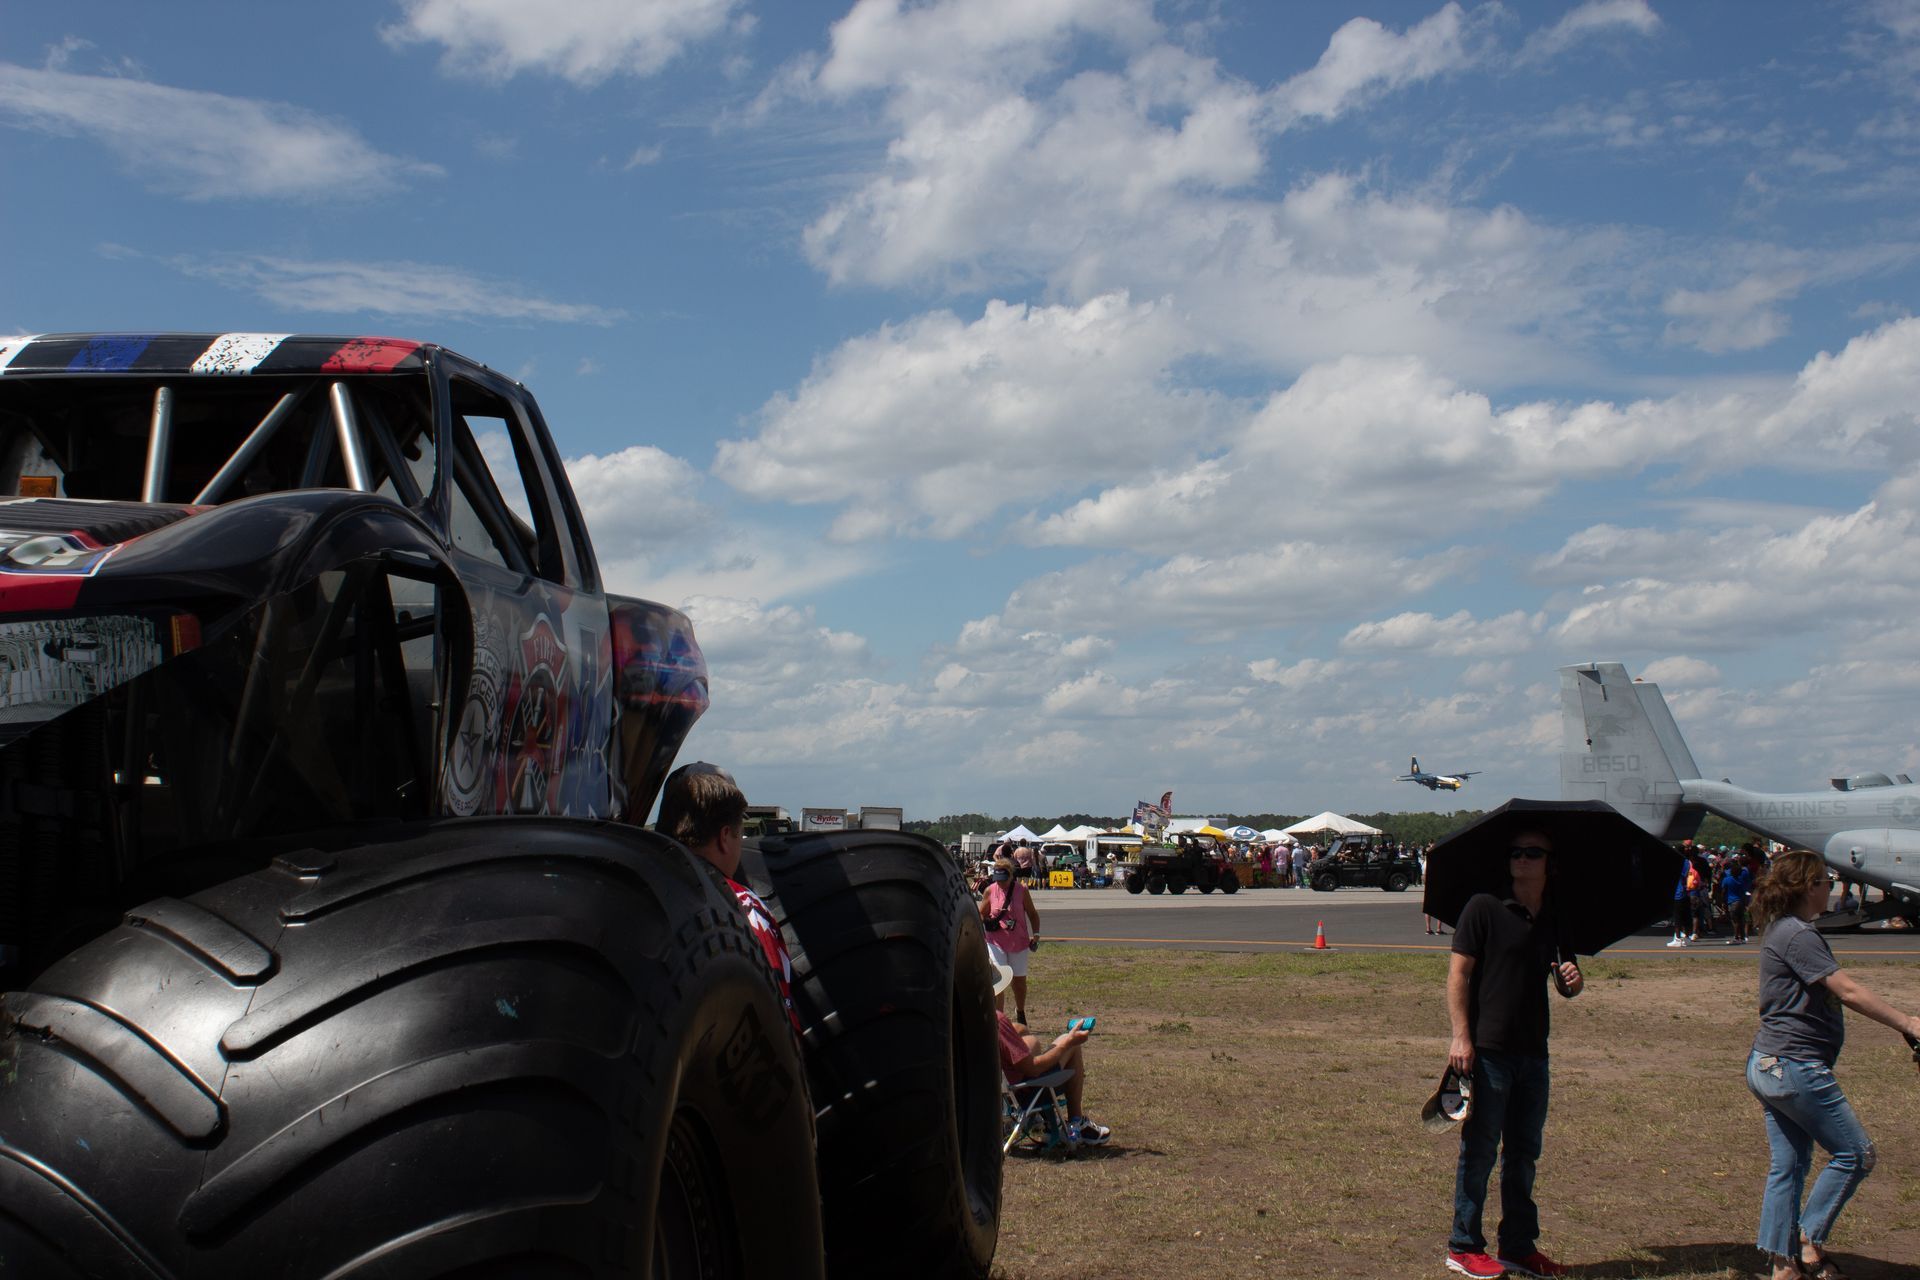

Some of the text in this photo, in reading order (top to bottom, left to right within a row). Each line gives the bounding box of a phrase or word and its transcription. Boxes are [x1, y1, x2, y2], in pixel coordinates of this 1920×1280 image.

[532, 635, 556, 667] FIRE
[472, 651, 499, 678] OLICE
[469, 676, 496, 715] FICER
[1582, 754, 1641, 773] 8650
[816, 814, 840, 823] Ryder
[1744, 800, 1848, 818] MARINES
